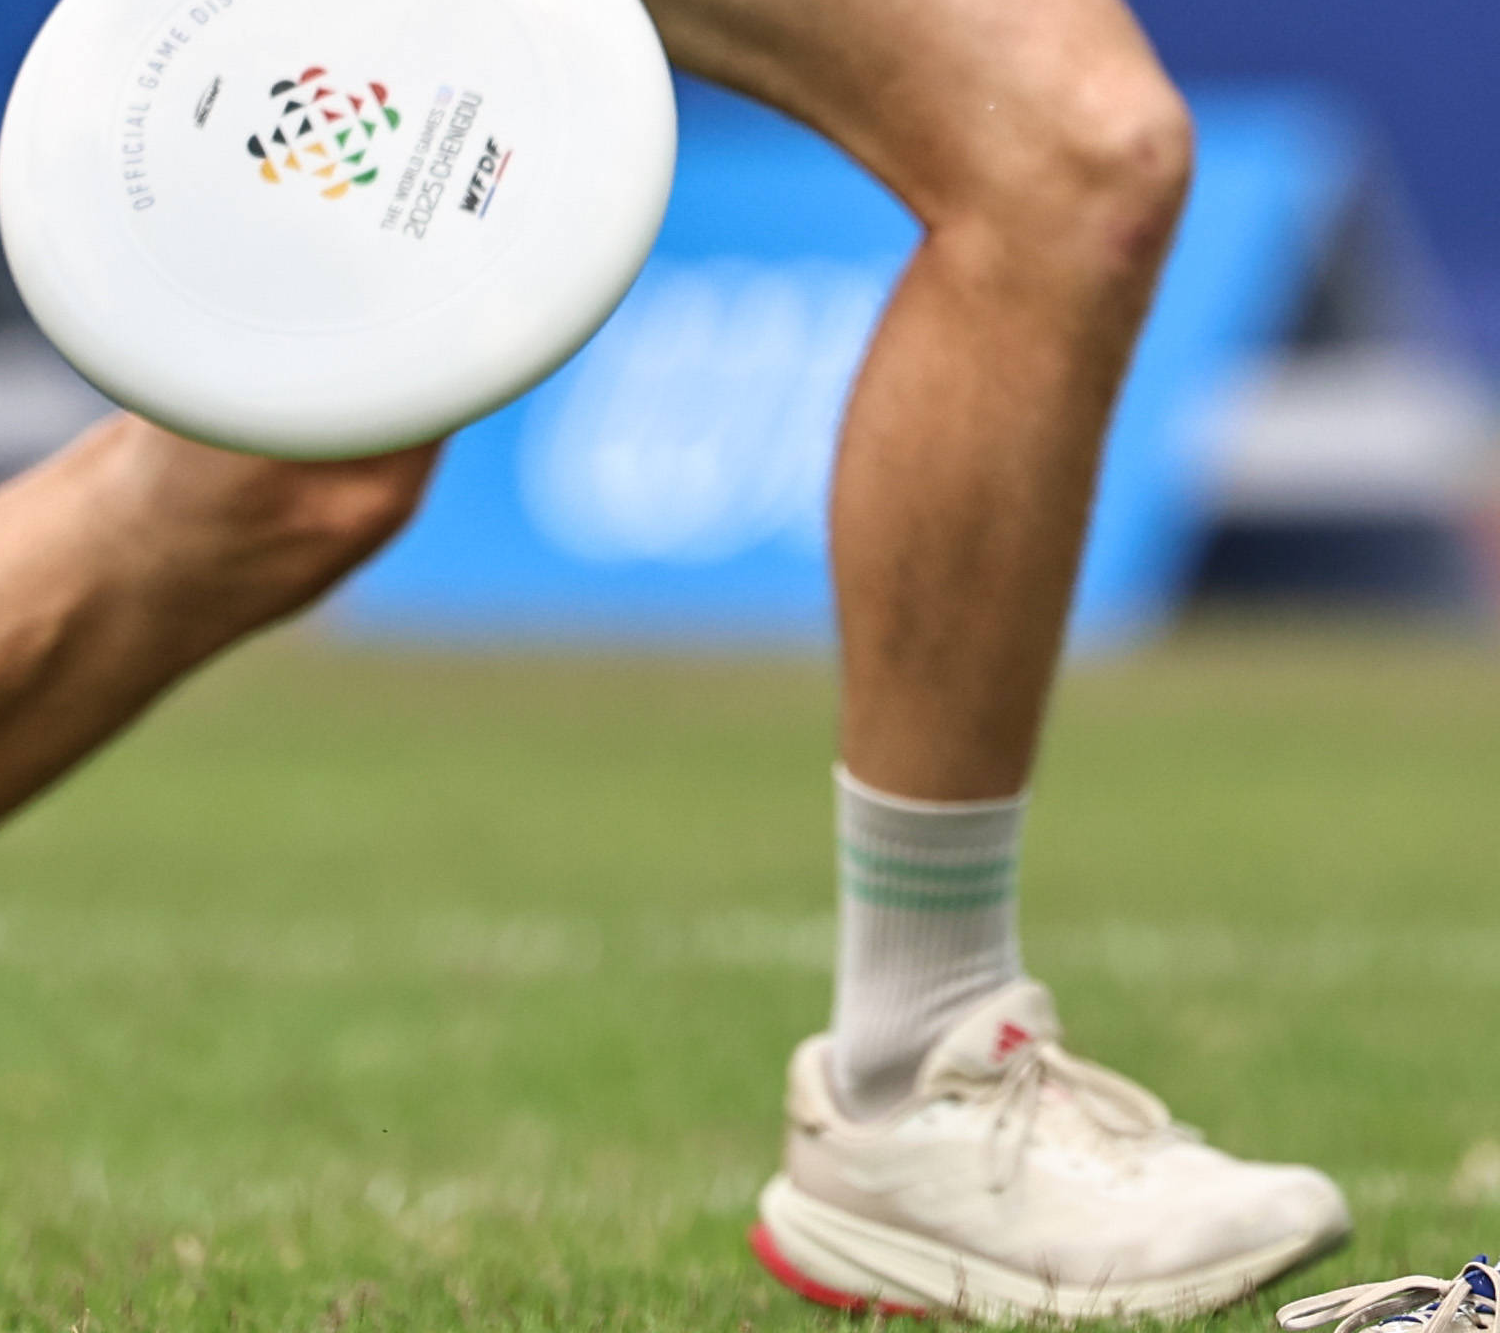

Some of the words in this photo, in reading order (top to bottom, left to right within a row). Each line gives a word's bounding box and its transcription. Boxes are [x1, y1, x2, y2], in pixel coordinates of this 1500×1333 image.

[137, 26, 191, 90] GAME
[122, 102, 156, 212] OFFICIAL
[403, 180, 445, 240] 2025
[428, 90, 484, 180] CHENGDU
[459, 136, 501, 214] WFDF
[380, 204, 404, 231] THE
